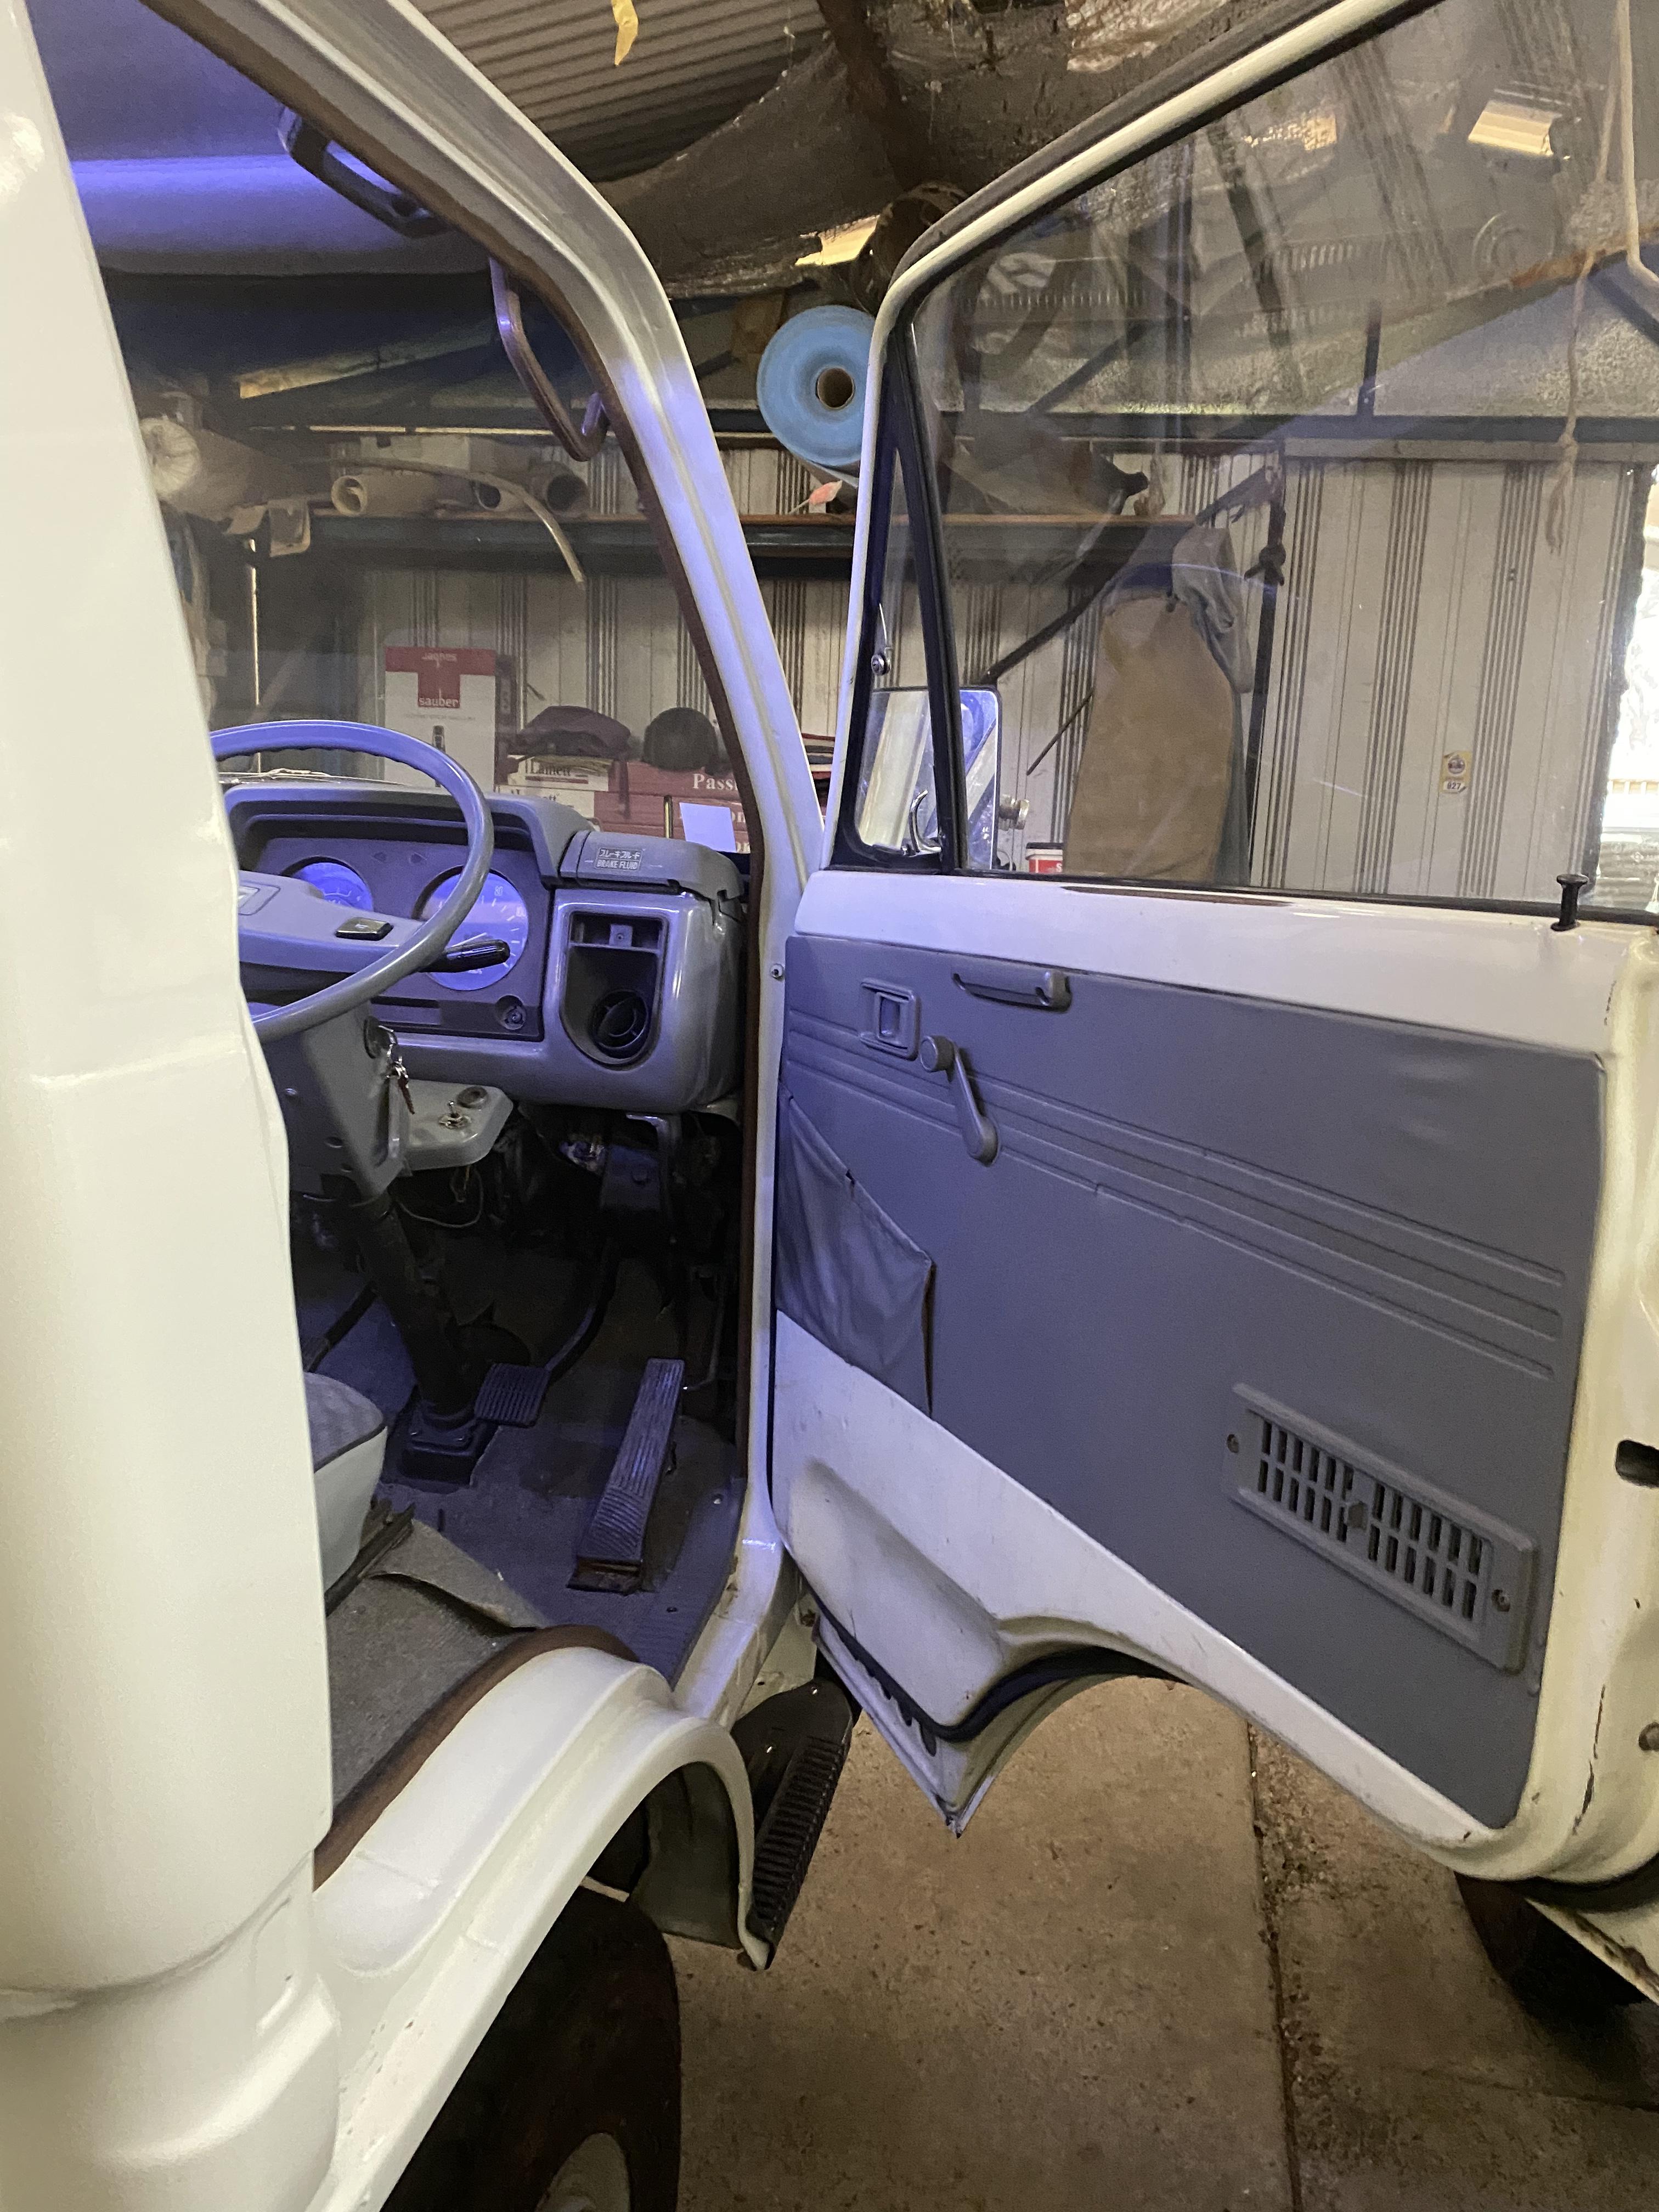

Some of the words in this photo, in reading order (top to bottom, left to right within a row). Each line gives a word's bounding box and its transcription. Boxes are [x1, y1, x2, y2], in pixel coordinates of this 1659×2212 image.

[419, 687, 459, 707] sauber
[596, 859, 618, 868] BRAKE
[619, 861, 638, 870] FLUID
